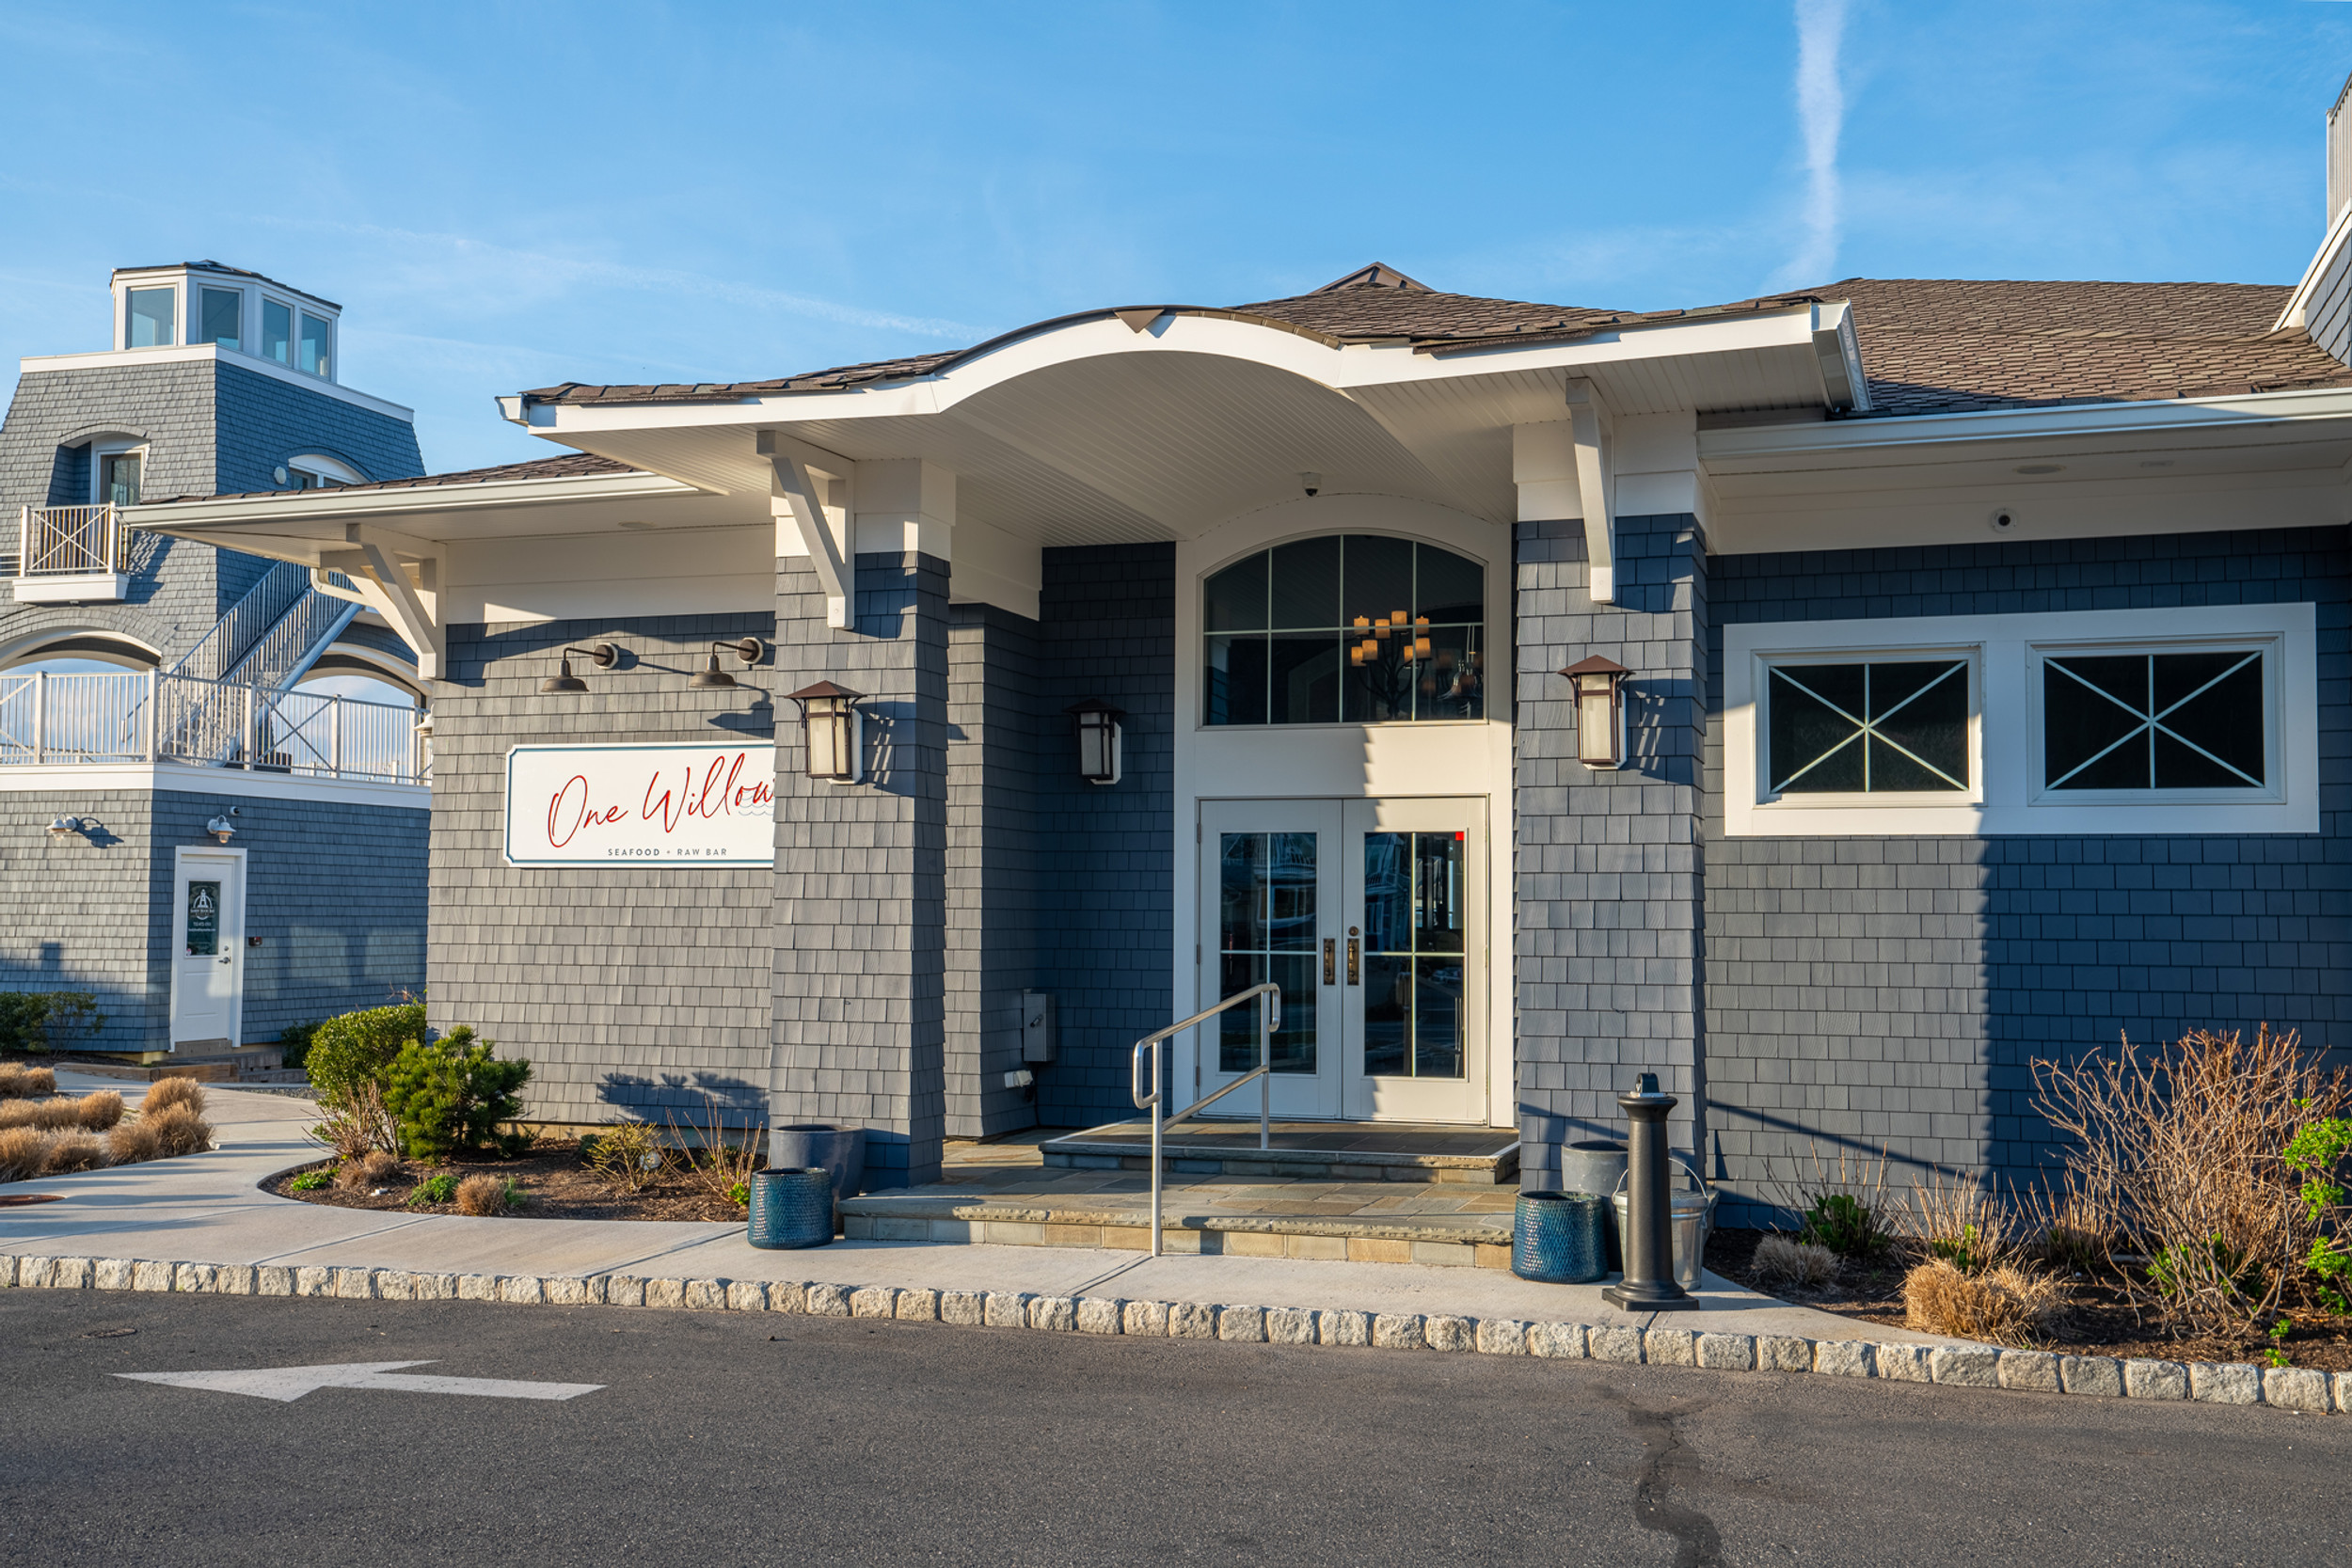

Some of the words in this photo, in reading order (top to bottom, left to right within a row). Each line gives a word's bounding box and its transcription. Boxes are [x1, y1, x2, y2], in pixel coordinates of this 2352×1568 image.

[548, 774, 628, 847] One
[608, 847, 660, 857] SEAFOOD
[676, 847, 700, 857] RAW
[706, 847, 727, 857] BAR
